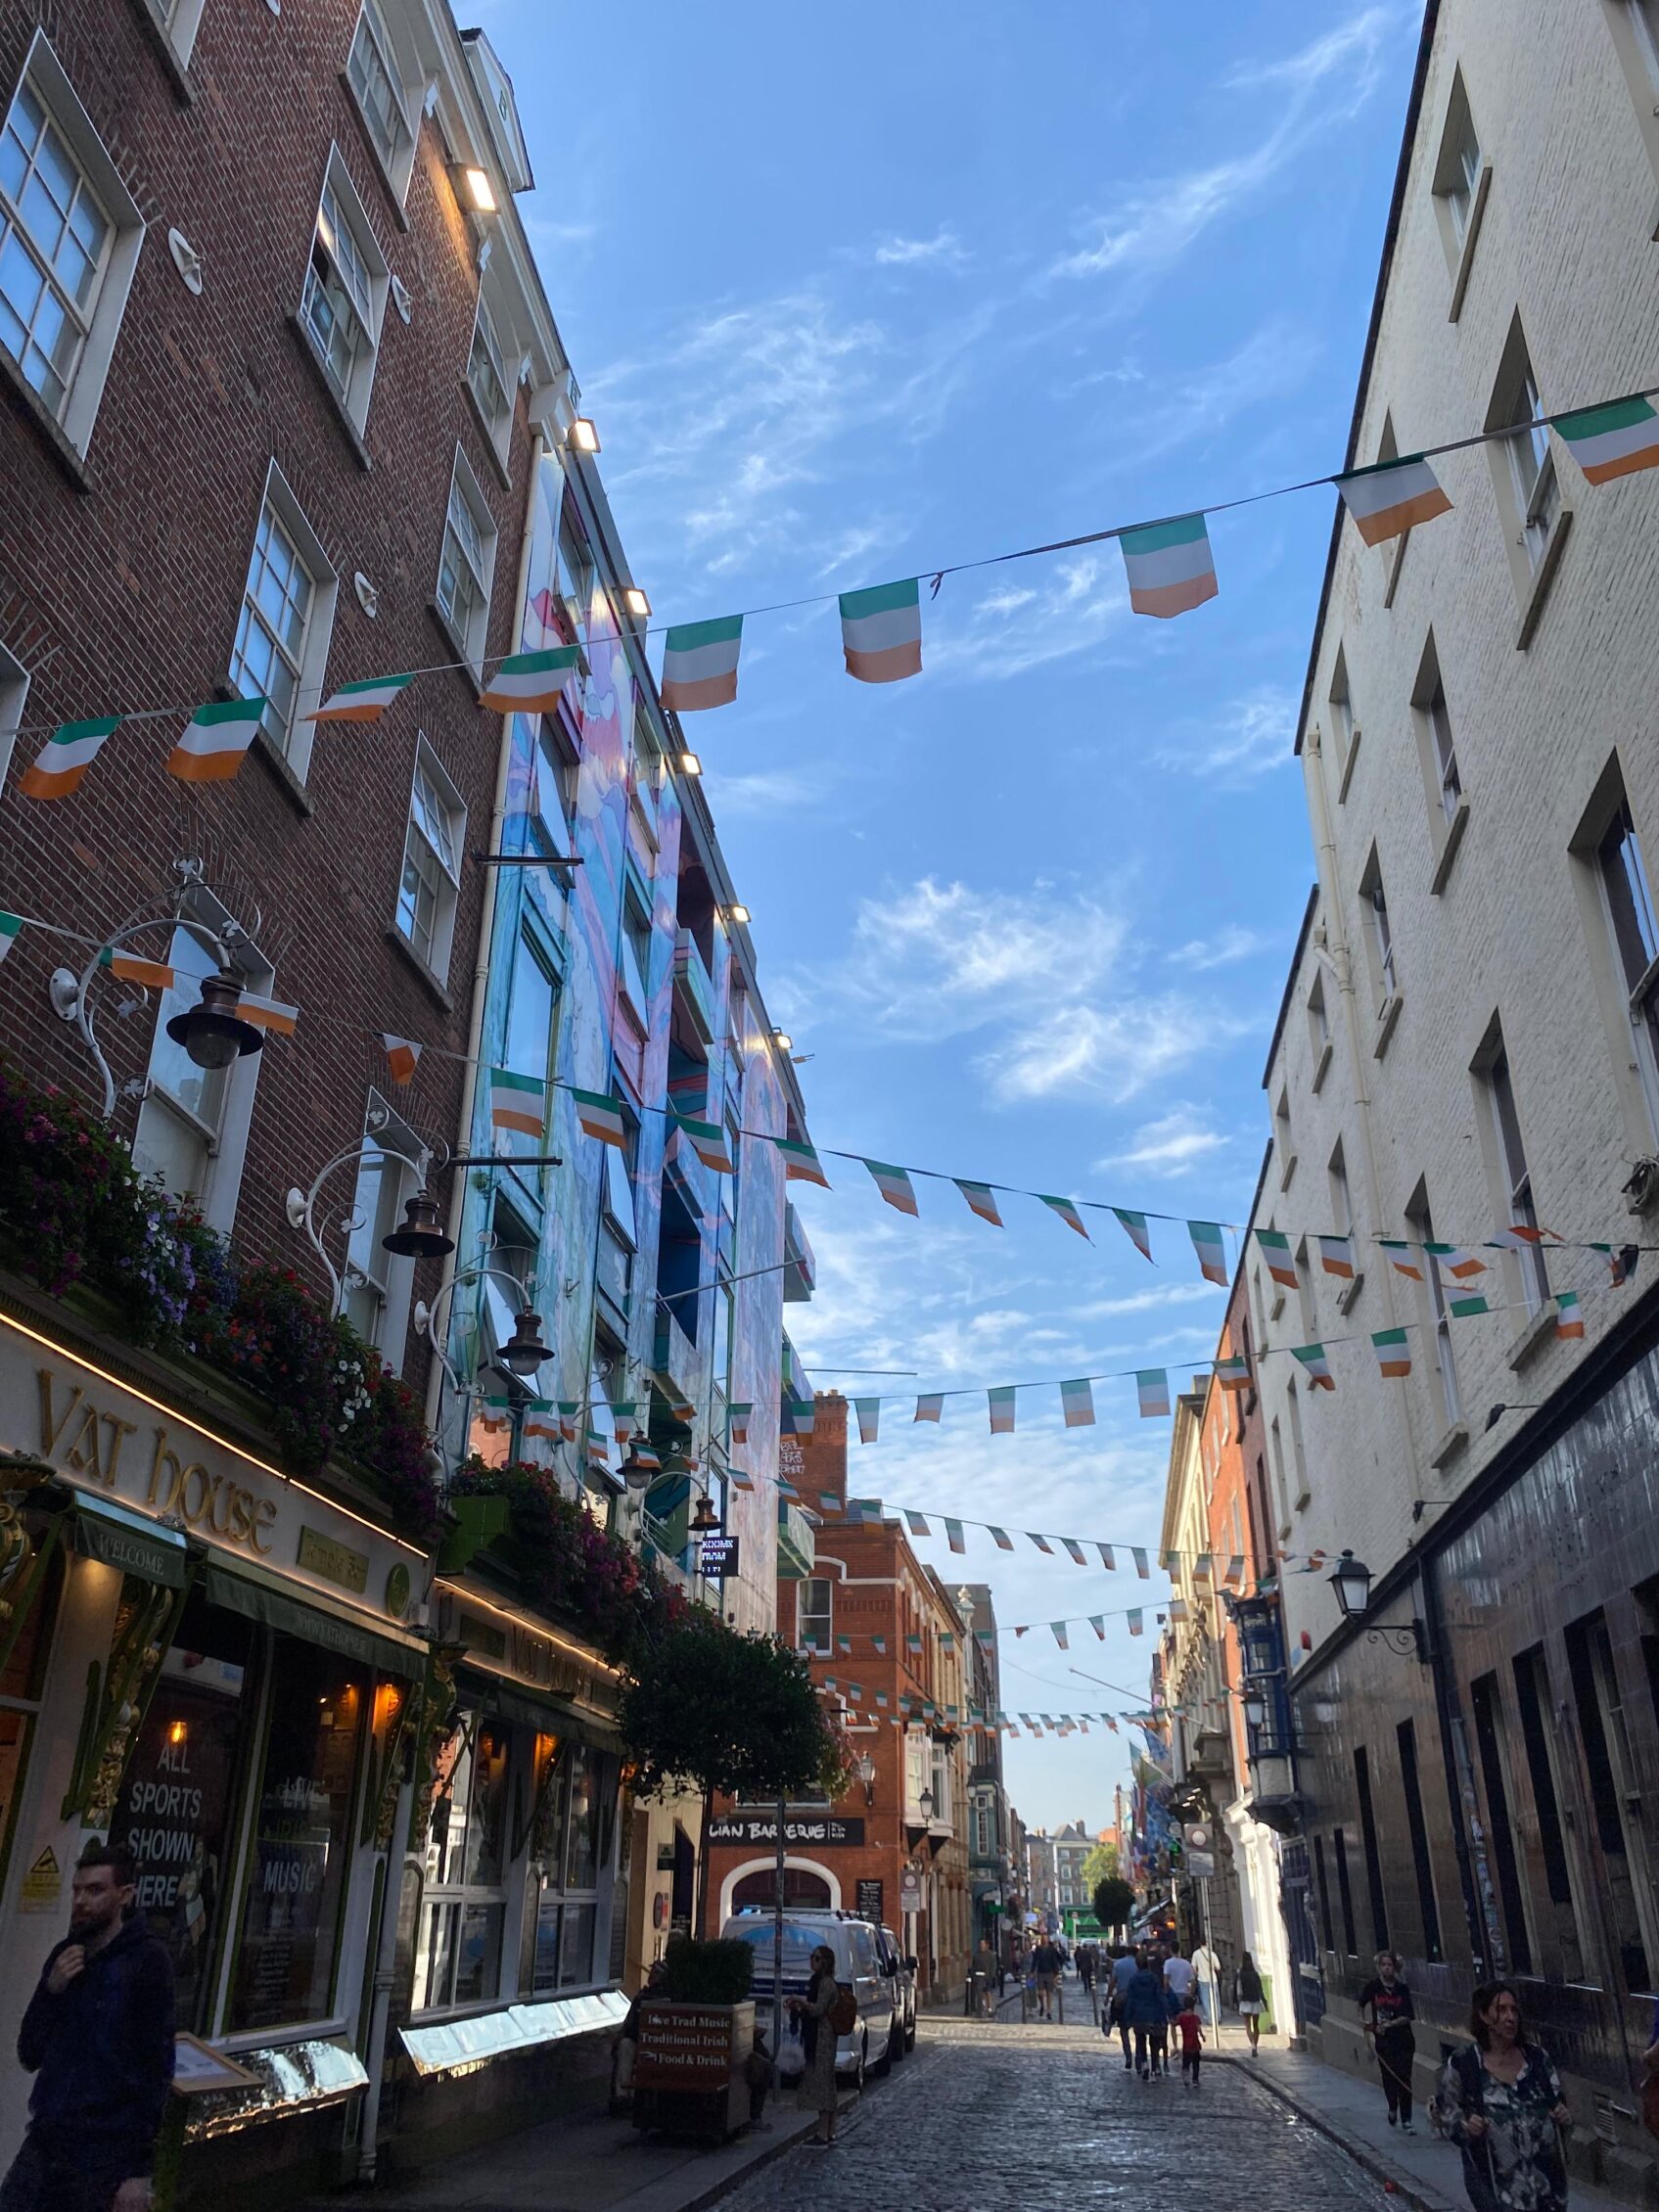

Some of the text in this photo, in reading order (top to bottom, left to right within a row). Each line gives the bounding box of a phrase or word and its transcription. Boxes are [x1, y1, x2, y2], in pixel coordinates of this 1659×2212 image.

[100, 1534, 164, 1576] WELCOME
[157, 1743, 191, 1774] ALL
[129, 1780, 203, 1820] SPORTS
[127, 1826, 196, 1864] SHOWN
[709, 1823, 744, 1838] LIAN
[748, 1822, 826, 1839] BAREQUE
[263, 1861, 316, 1894] MUSIC
[672, 2016, 696, 2027] Trad
[699, 2017, 730, 2028] Music
[641, 2032, 728, 2047] Traditional Irish
[659, 2053, 726, 2066] Food & Drink
